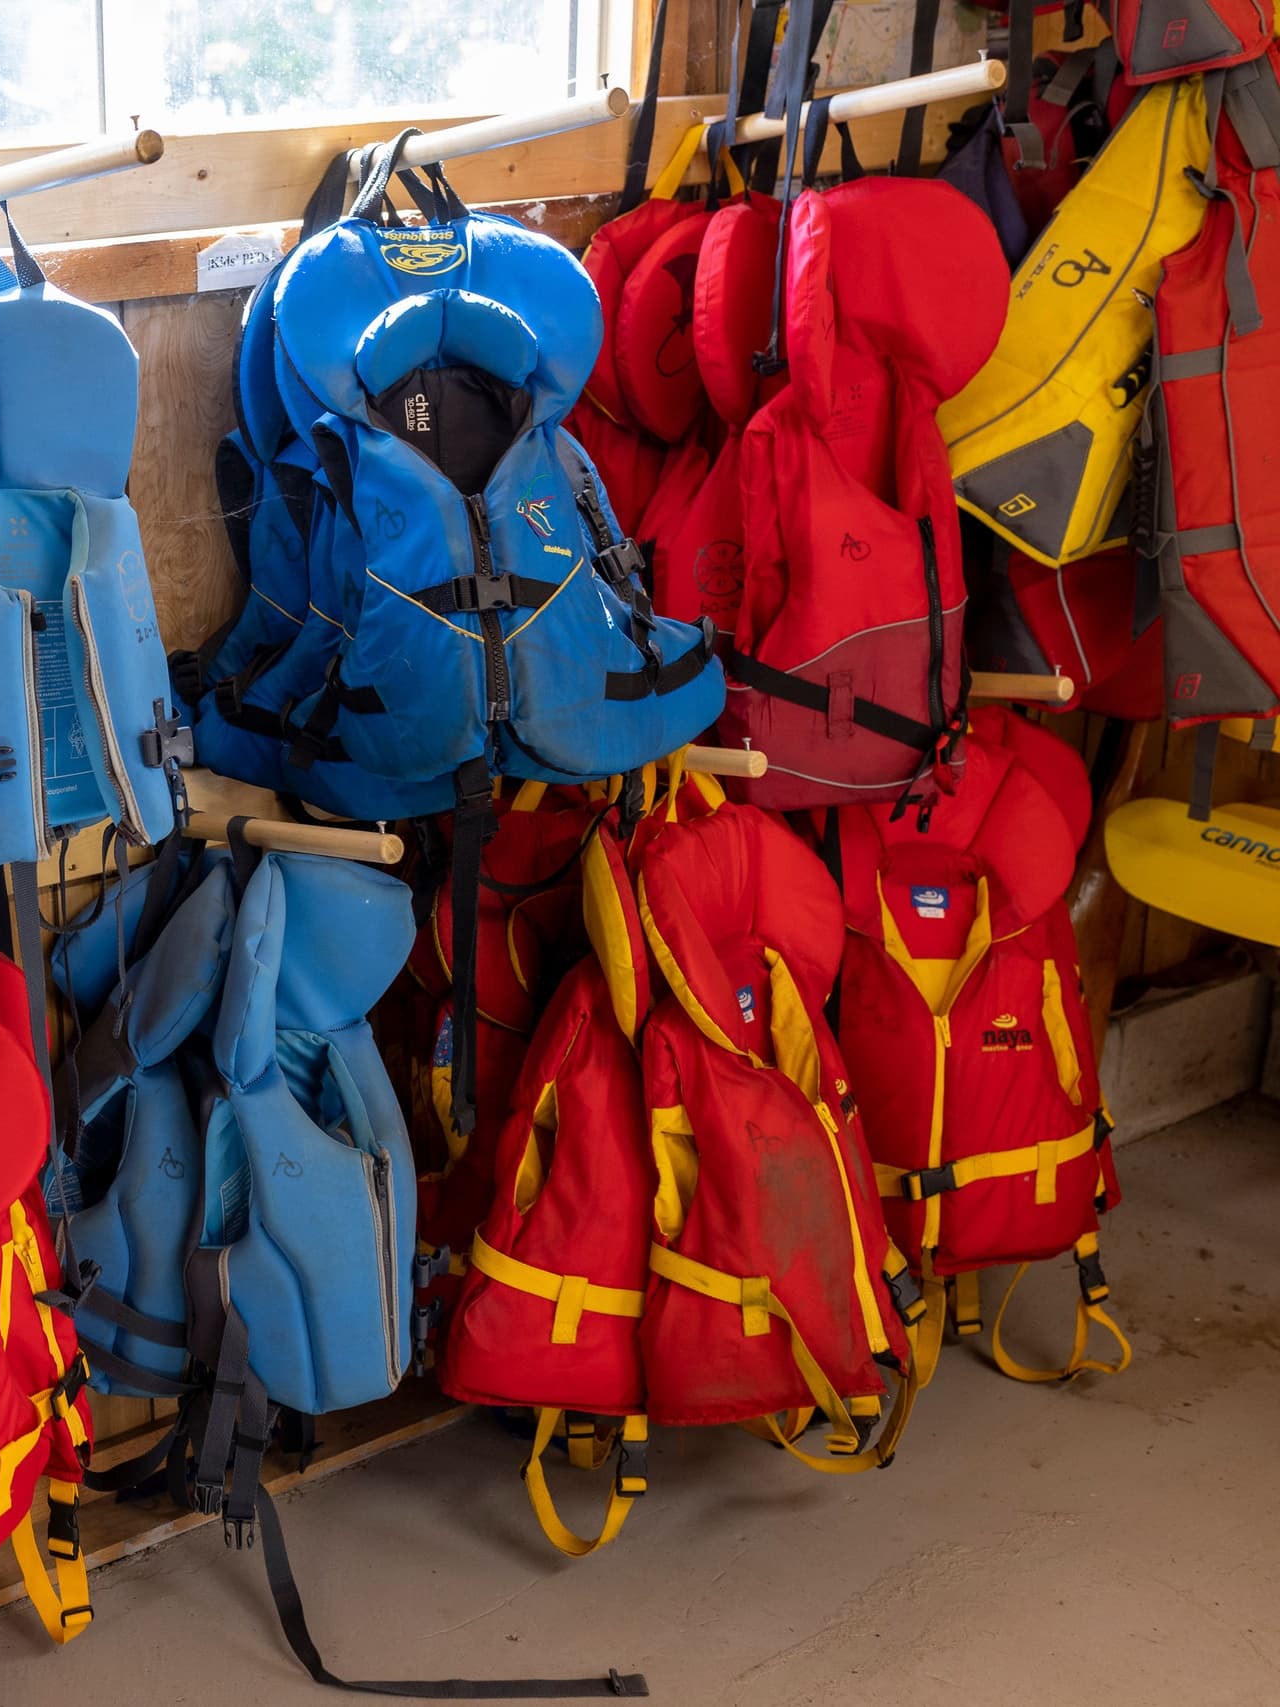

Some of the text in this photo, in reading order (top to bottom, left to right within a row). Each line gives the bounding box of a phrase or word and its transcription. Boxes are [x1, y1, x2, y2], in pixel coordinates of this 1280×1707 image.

[415, 393, 431, 432] child
[1201, 827, 1280, 862] canno
[982, 1029, 1033, 1049] naya
